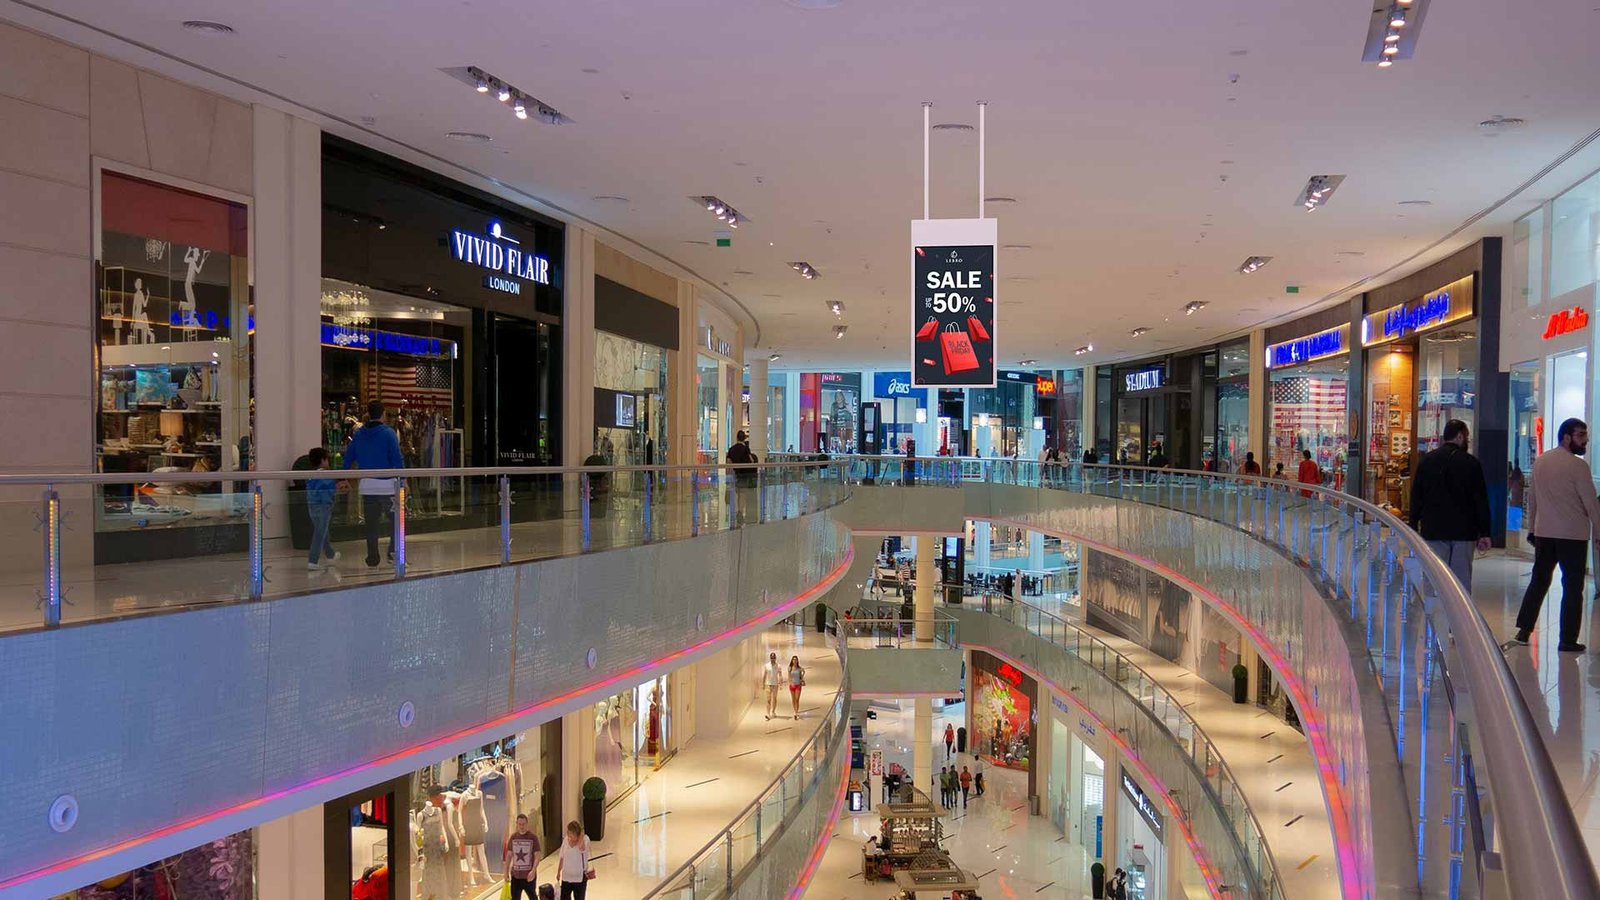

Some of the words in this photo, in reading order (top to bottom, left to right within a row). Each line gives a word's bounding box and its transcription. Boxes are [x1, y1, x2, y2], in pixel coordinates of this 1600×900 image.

[455, 231, 504, 270] VIVID
[508, 248, 549, 285] FLAIR
[489, 276, 520, 295] LONDON
[926, 271, 981, 289] SALE
[933, 292, 976, 313] 50%
